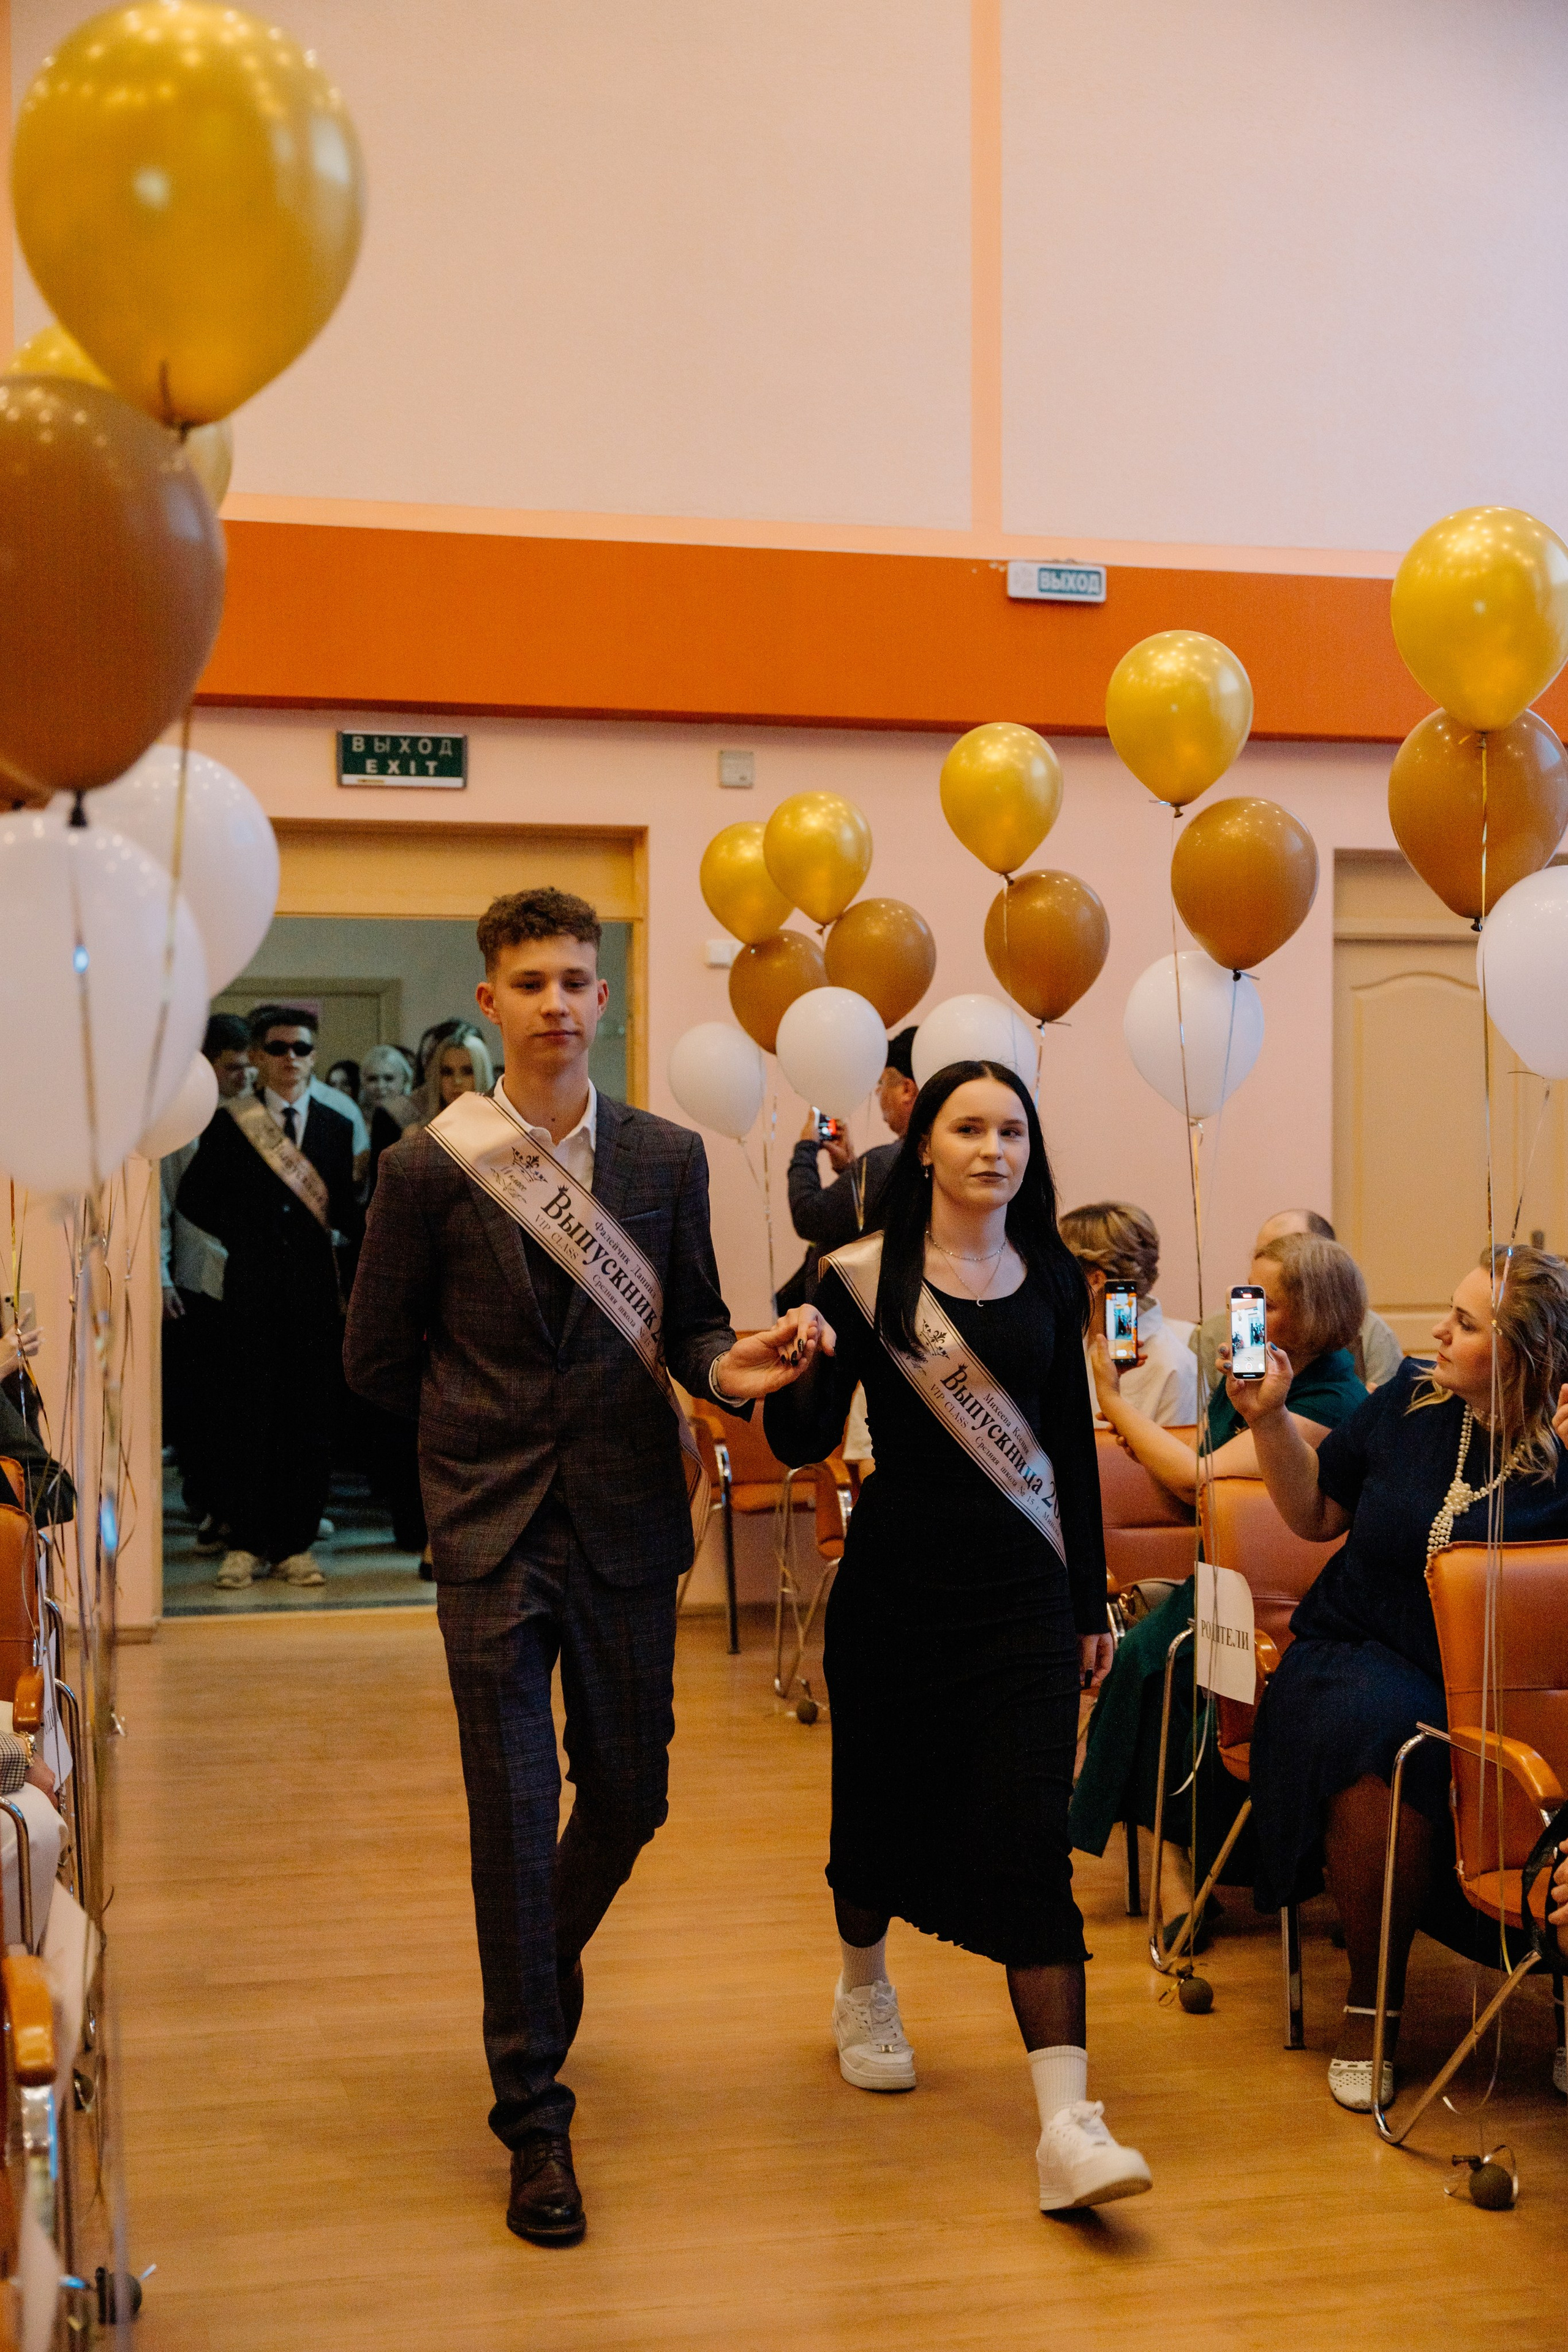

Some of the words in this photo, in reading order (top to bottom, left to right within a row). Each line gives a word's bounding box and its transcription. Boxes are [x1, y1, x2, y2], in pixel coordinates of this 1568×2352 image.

[1040, 571, 1099, 592] ВЫХОД
[351, 735, 453, 757] ВЫХОД
[365, 758, 438, 777] EXIT
[535, 1214, 551, 1231] VIP
[551, 1232, 578, 1260] CLASS
[540, 1189, 657, 1330] Выпускник
[592, 1275, 617, 1305] Средняя
[618, 1305, 636, 1328] школа
[930, 1384, 945, 1400] VIP
[944, 1401, 969, 1428] CLASS
[983, 1393, 1012, 1428] Михеева
[1012, 1427, 1030, 1455] Ксения
[940, 1368, 1043, 1495] Выпускница
[975, 1436, 1000, 1466] Средняя
[1000, 1466, 1017, 1487] школа
[1017, 1486, 1025, 1496] №
[1027, 1496, 1035, 1505] 15
